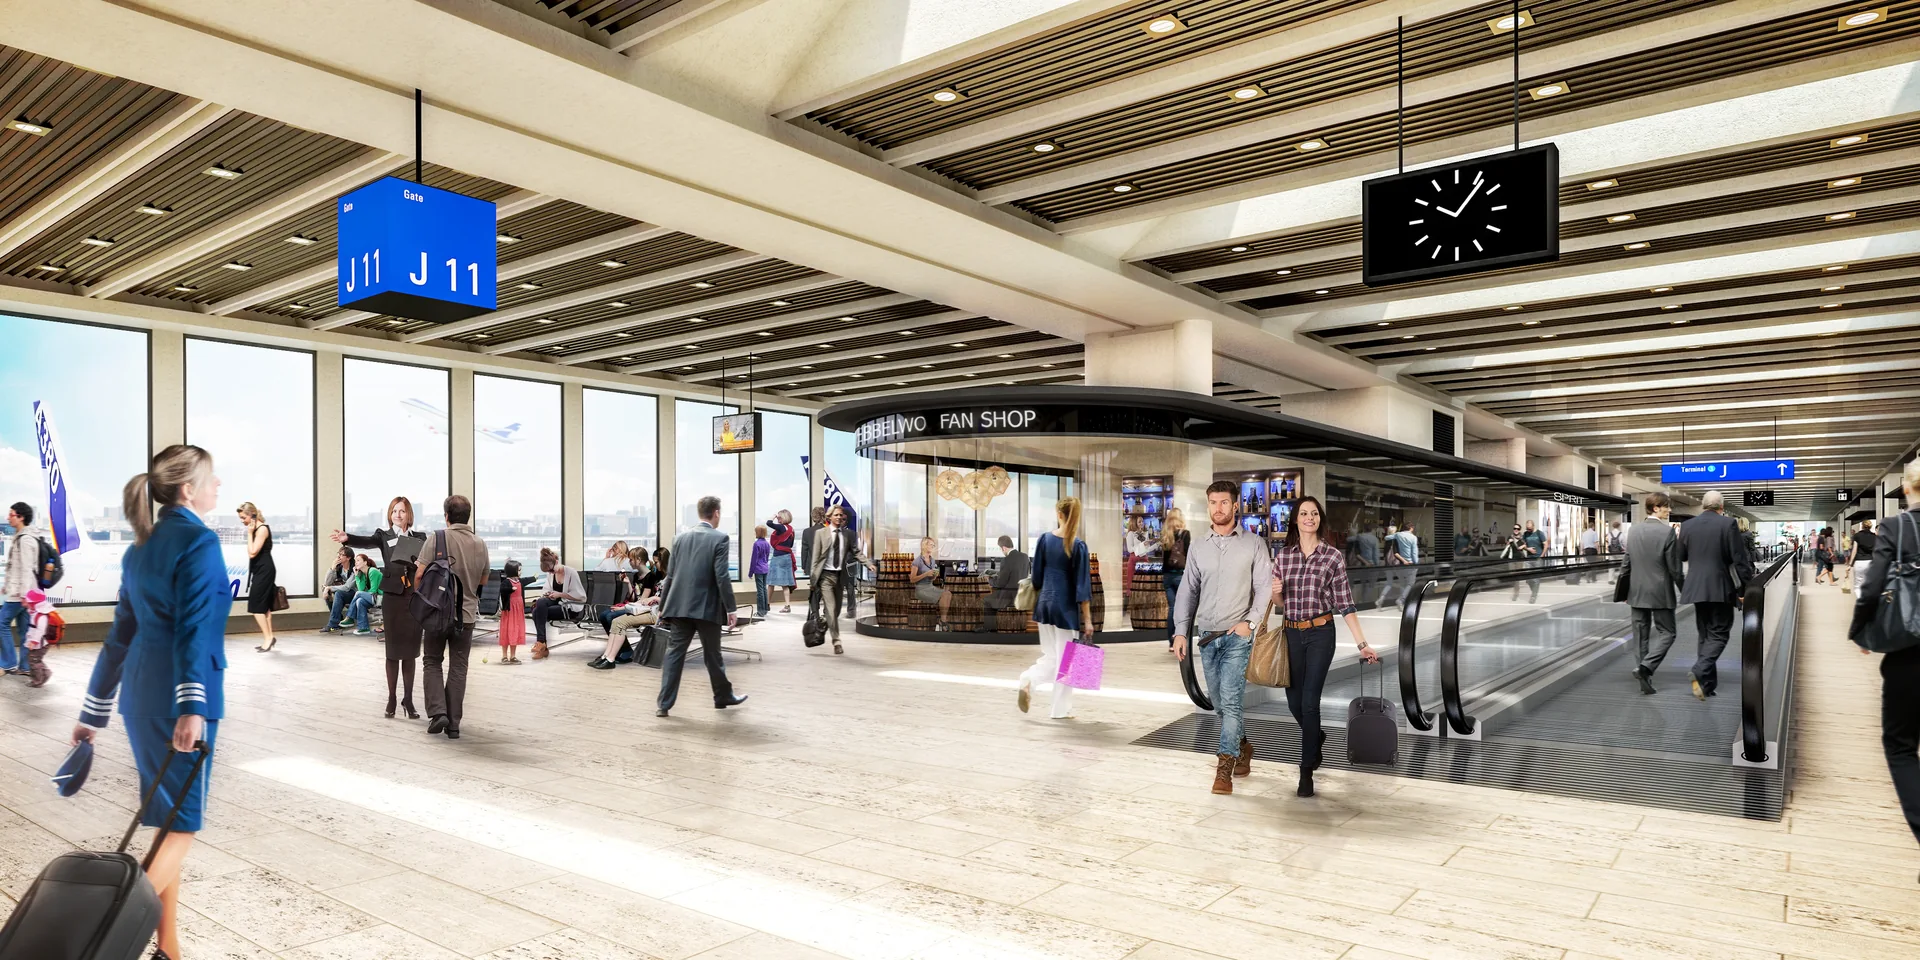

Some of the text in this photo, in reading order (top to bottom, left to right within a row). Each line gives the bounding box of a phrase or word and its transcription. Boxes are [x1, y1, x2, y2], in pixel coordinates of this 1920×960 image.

[404, 189, 424, 203] Gate
[346, 248, 380, 293] J 11
[409, 252, 478, 296] J 11
[940, 412, 973, 430] FAN
[980, 410, 1037, 428] SHOP
[1719, 465, 1727, 478] J
